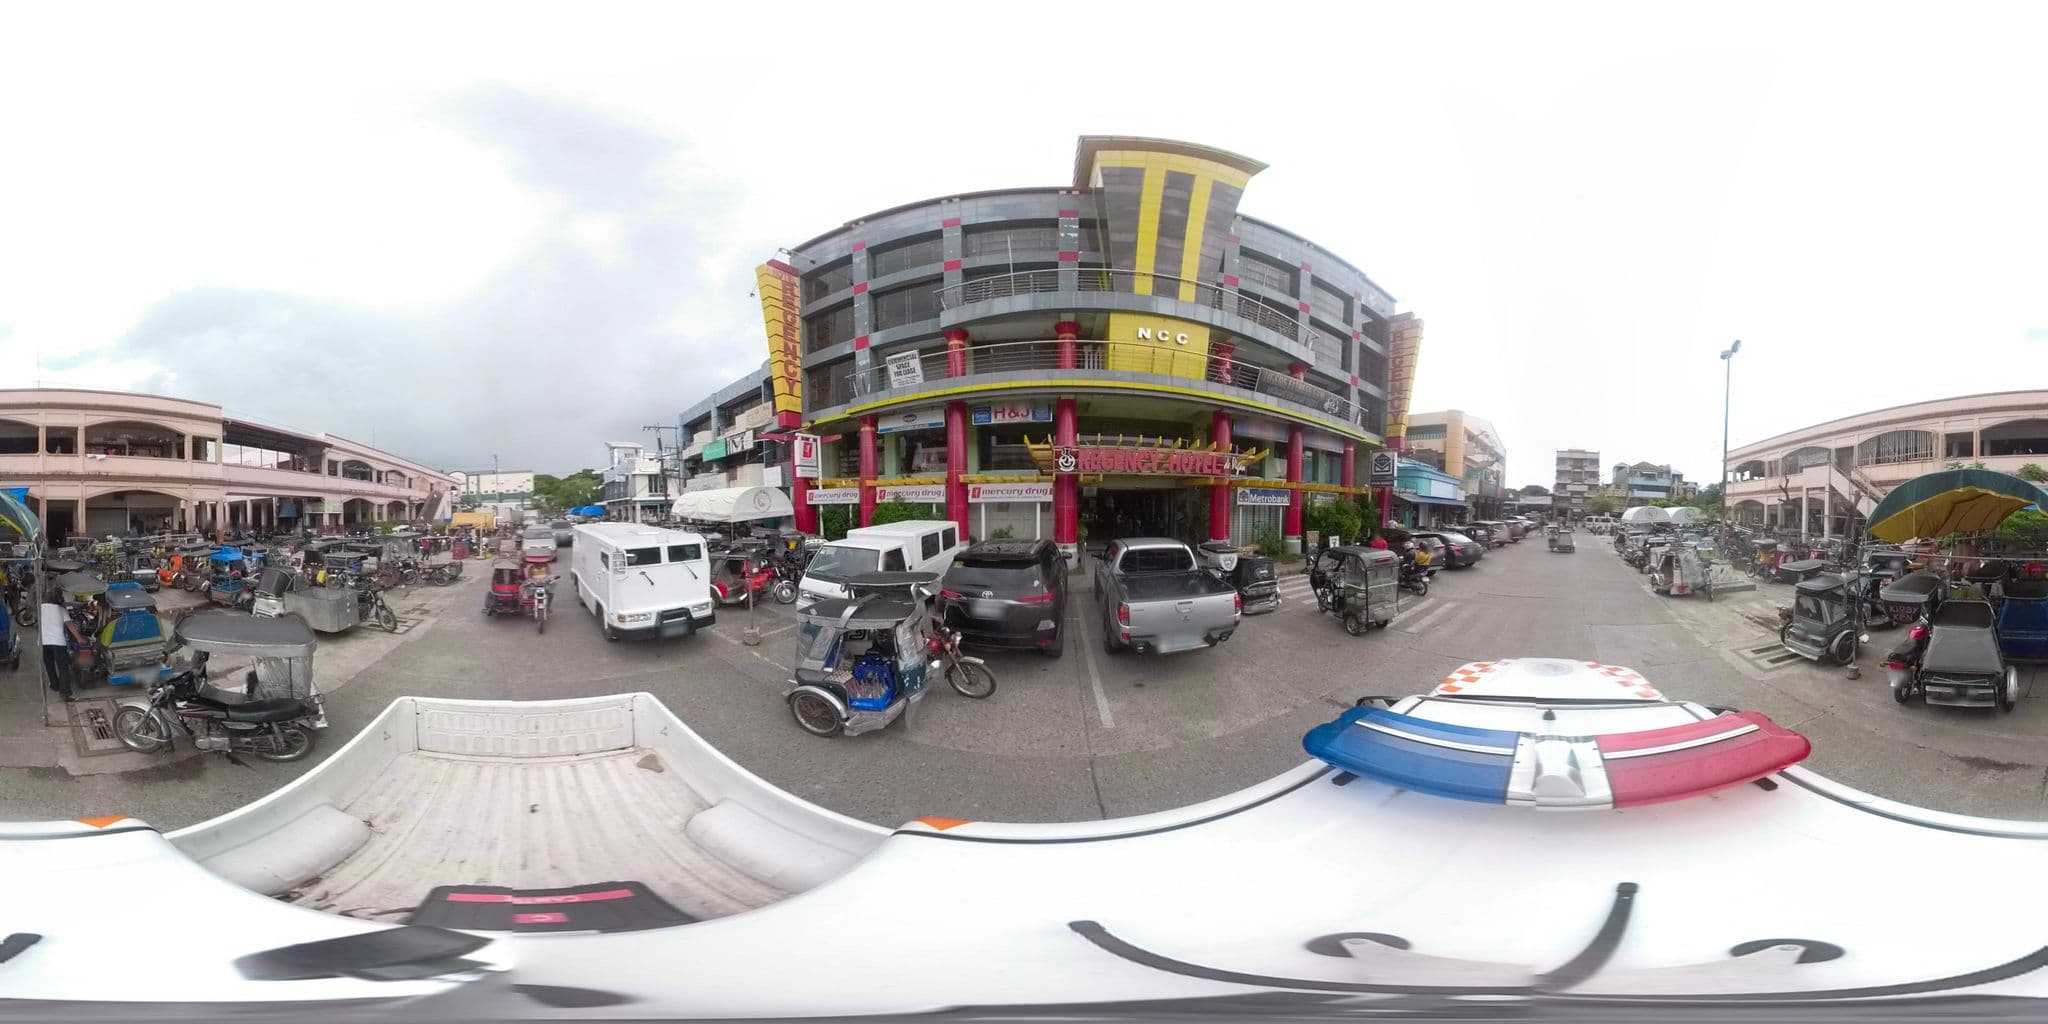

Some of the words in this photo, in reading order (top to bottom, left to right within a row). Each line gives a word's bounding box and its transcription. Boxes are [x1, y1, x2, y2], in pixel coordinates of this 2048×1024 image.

[781, 279, 798, 395] REGENCY
[1137, 327, 1188, 345] NCC
[1391, 330, 1404, 425] REGENCY
[1079, 449, 1159, 472] REGENCY
[1168, 451, 1222, 475] HOTEL
[815, 491, 840, 500] mercury
[841, 491, 858, 499] drug
[886, 489, 921, 498] mercury
[921, 488, 943, 497] drug
[981, 487, 1024, 497] mercury
[1025, 486, 1048, 496] drug
[1249, 493, 1289, 503] Metrobank
